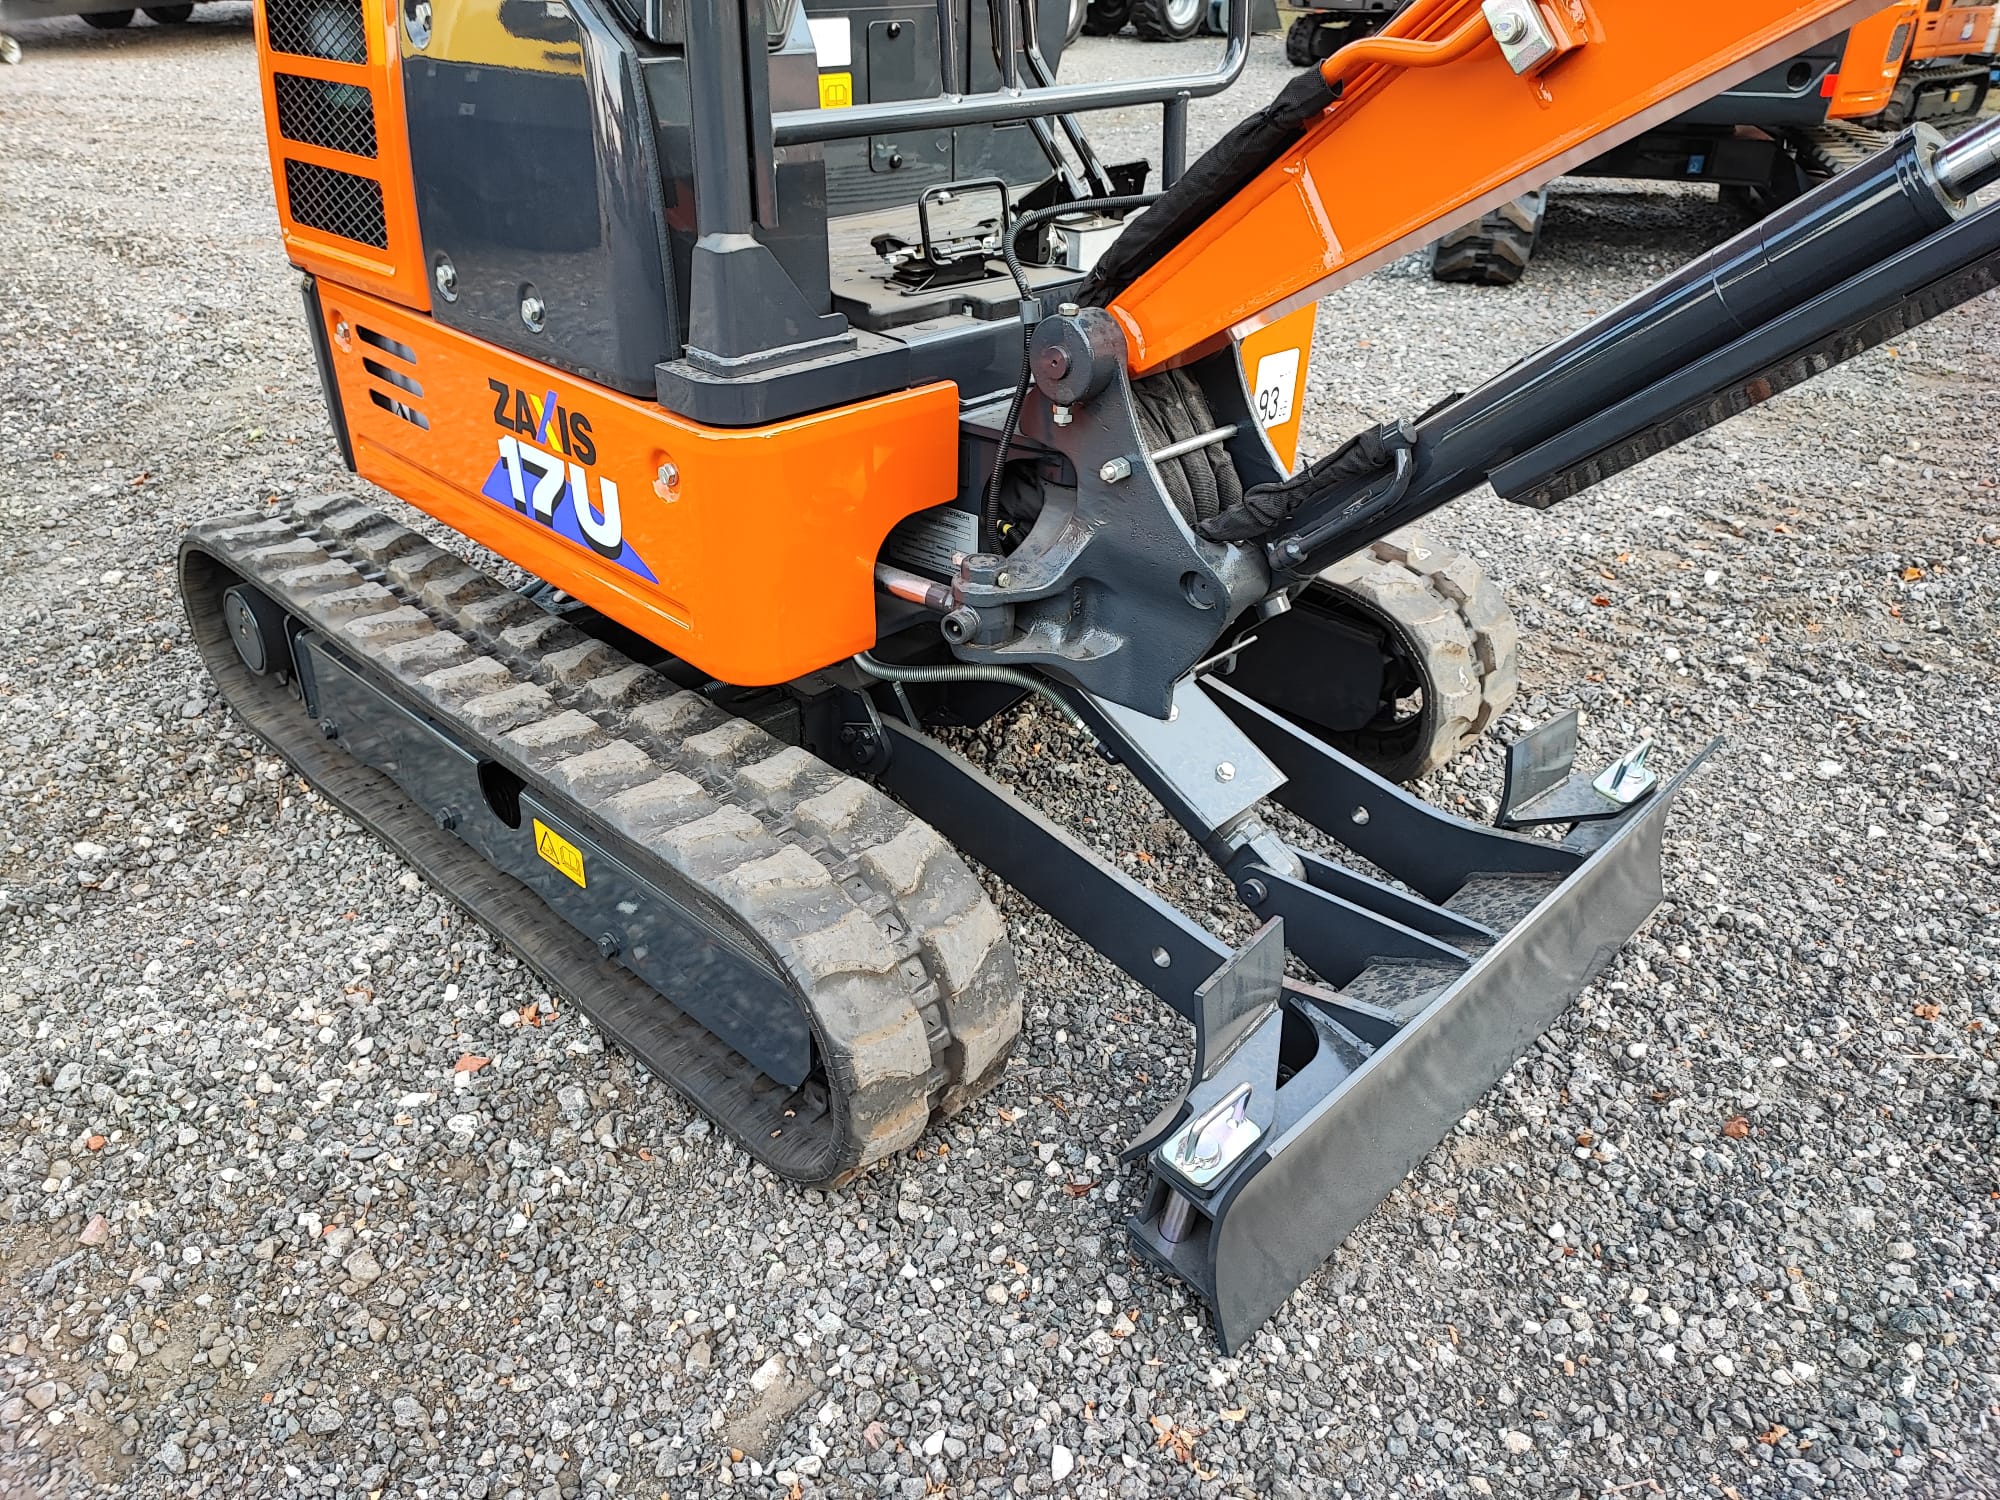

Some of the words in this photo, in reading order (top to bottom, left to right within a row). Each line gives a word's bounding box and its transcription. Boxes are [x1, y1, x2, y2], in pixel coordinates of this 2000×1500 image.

[488, 377, 597, 466] ZAXIS
[1260, 387, 1280, 422] 93
[497, 434, 623, 558] 17U
[946, 510, 970, 521] HITACHI
